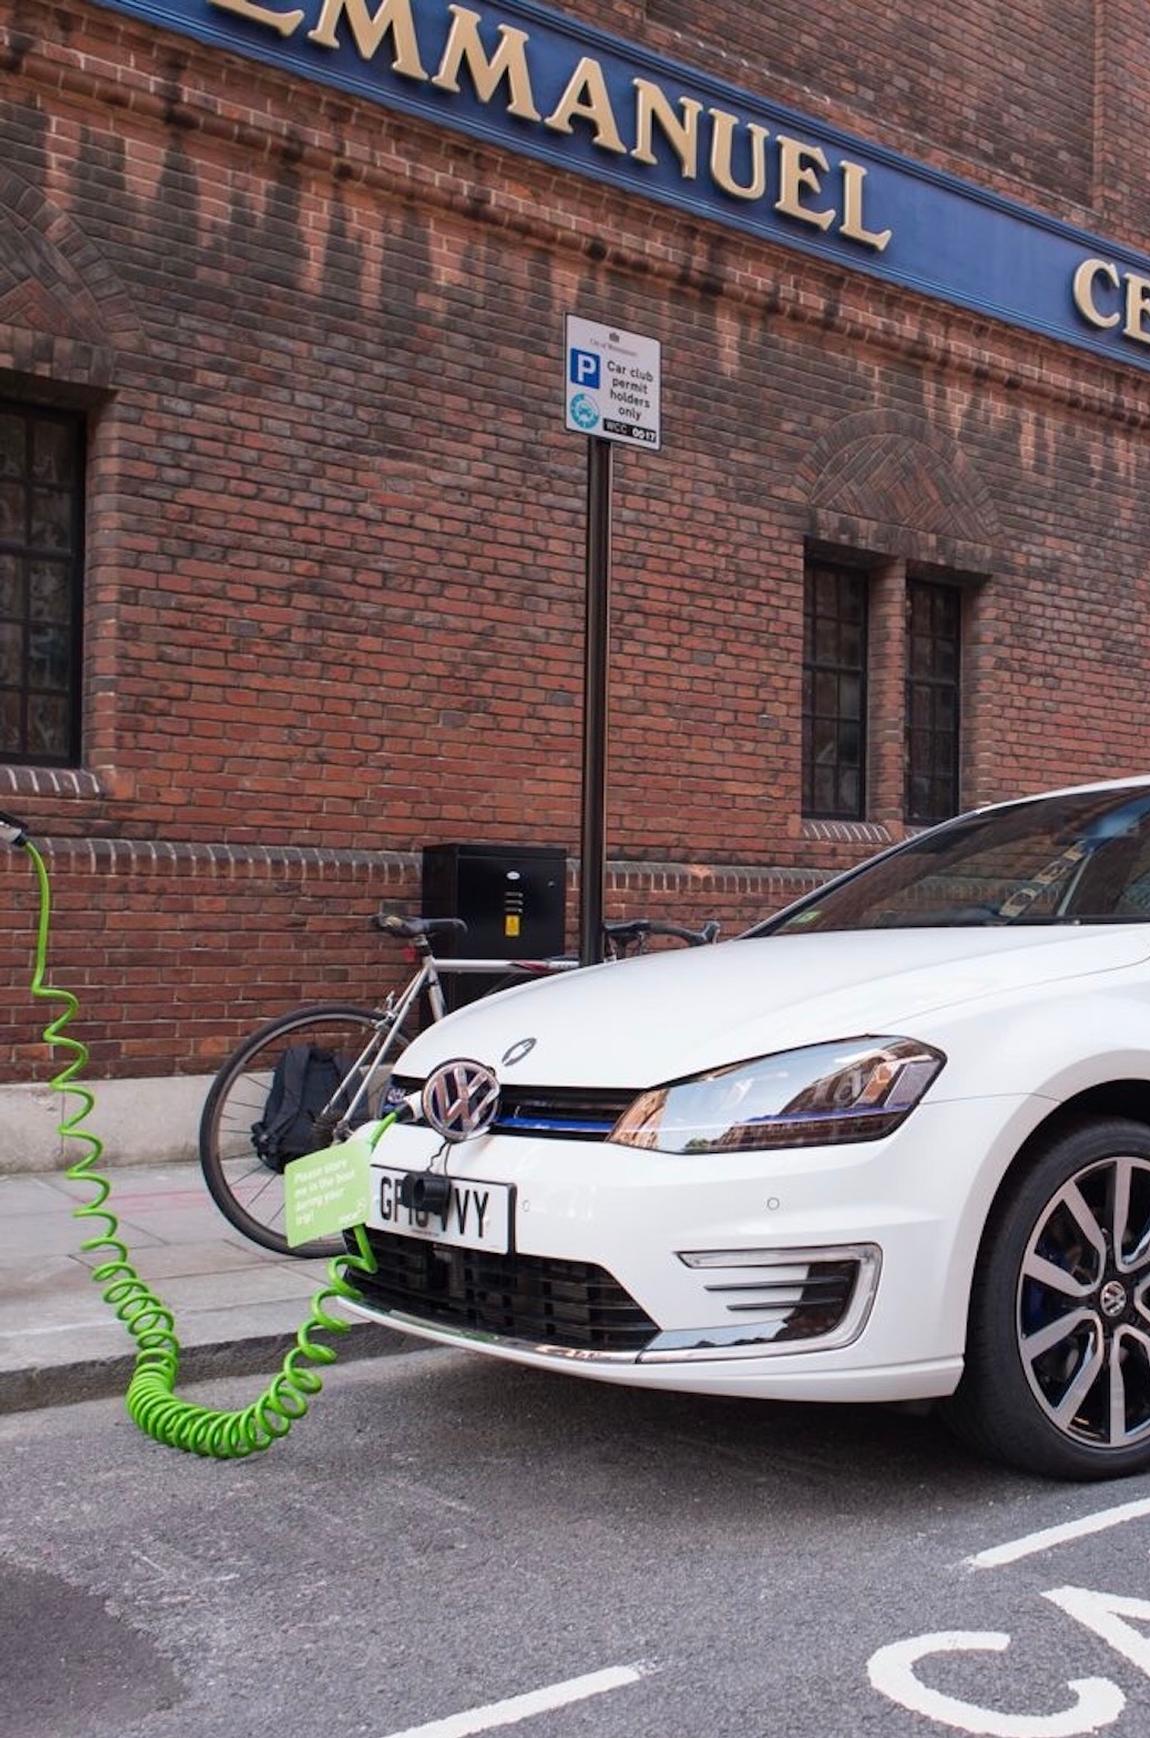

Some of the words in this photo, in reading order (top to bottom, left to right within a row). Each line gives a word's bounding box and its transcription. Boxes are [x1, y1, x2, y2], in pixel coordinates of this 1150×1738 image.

[577, 353, 596, 382] P
[606, 360, 626, 375] Car
[629, 366, 654, 383] club
[612, 377, 648, 395] permit
[610, 389, 651, 408] holders
[618, 406, 642, 421] only
[606, 421, 628, 434] WCC
[426, 1062, 498, 1138] VW
